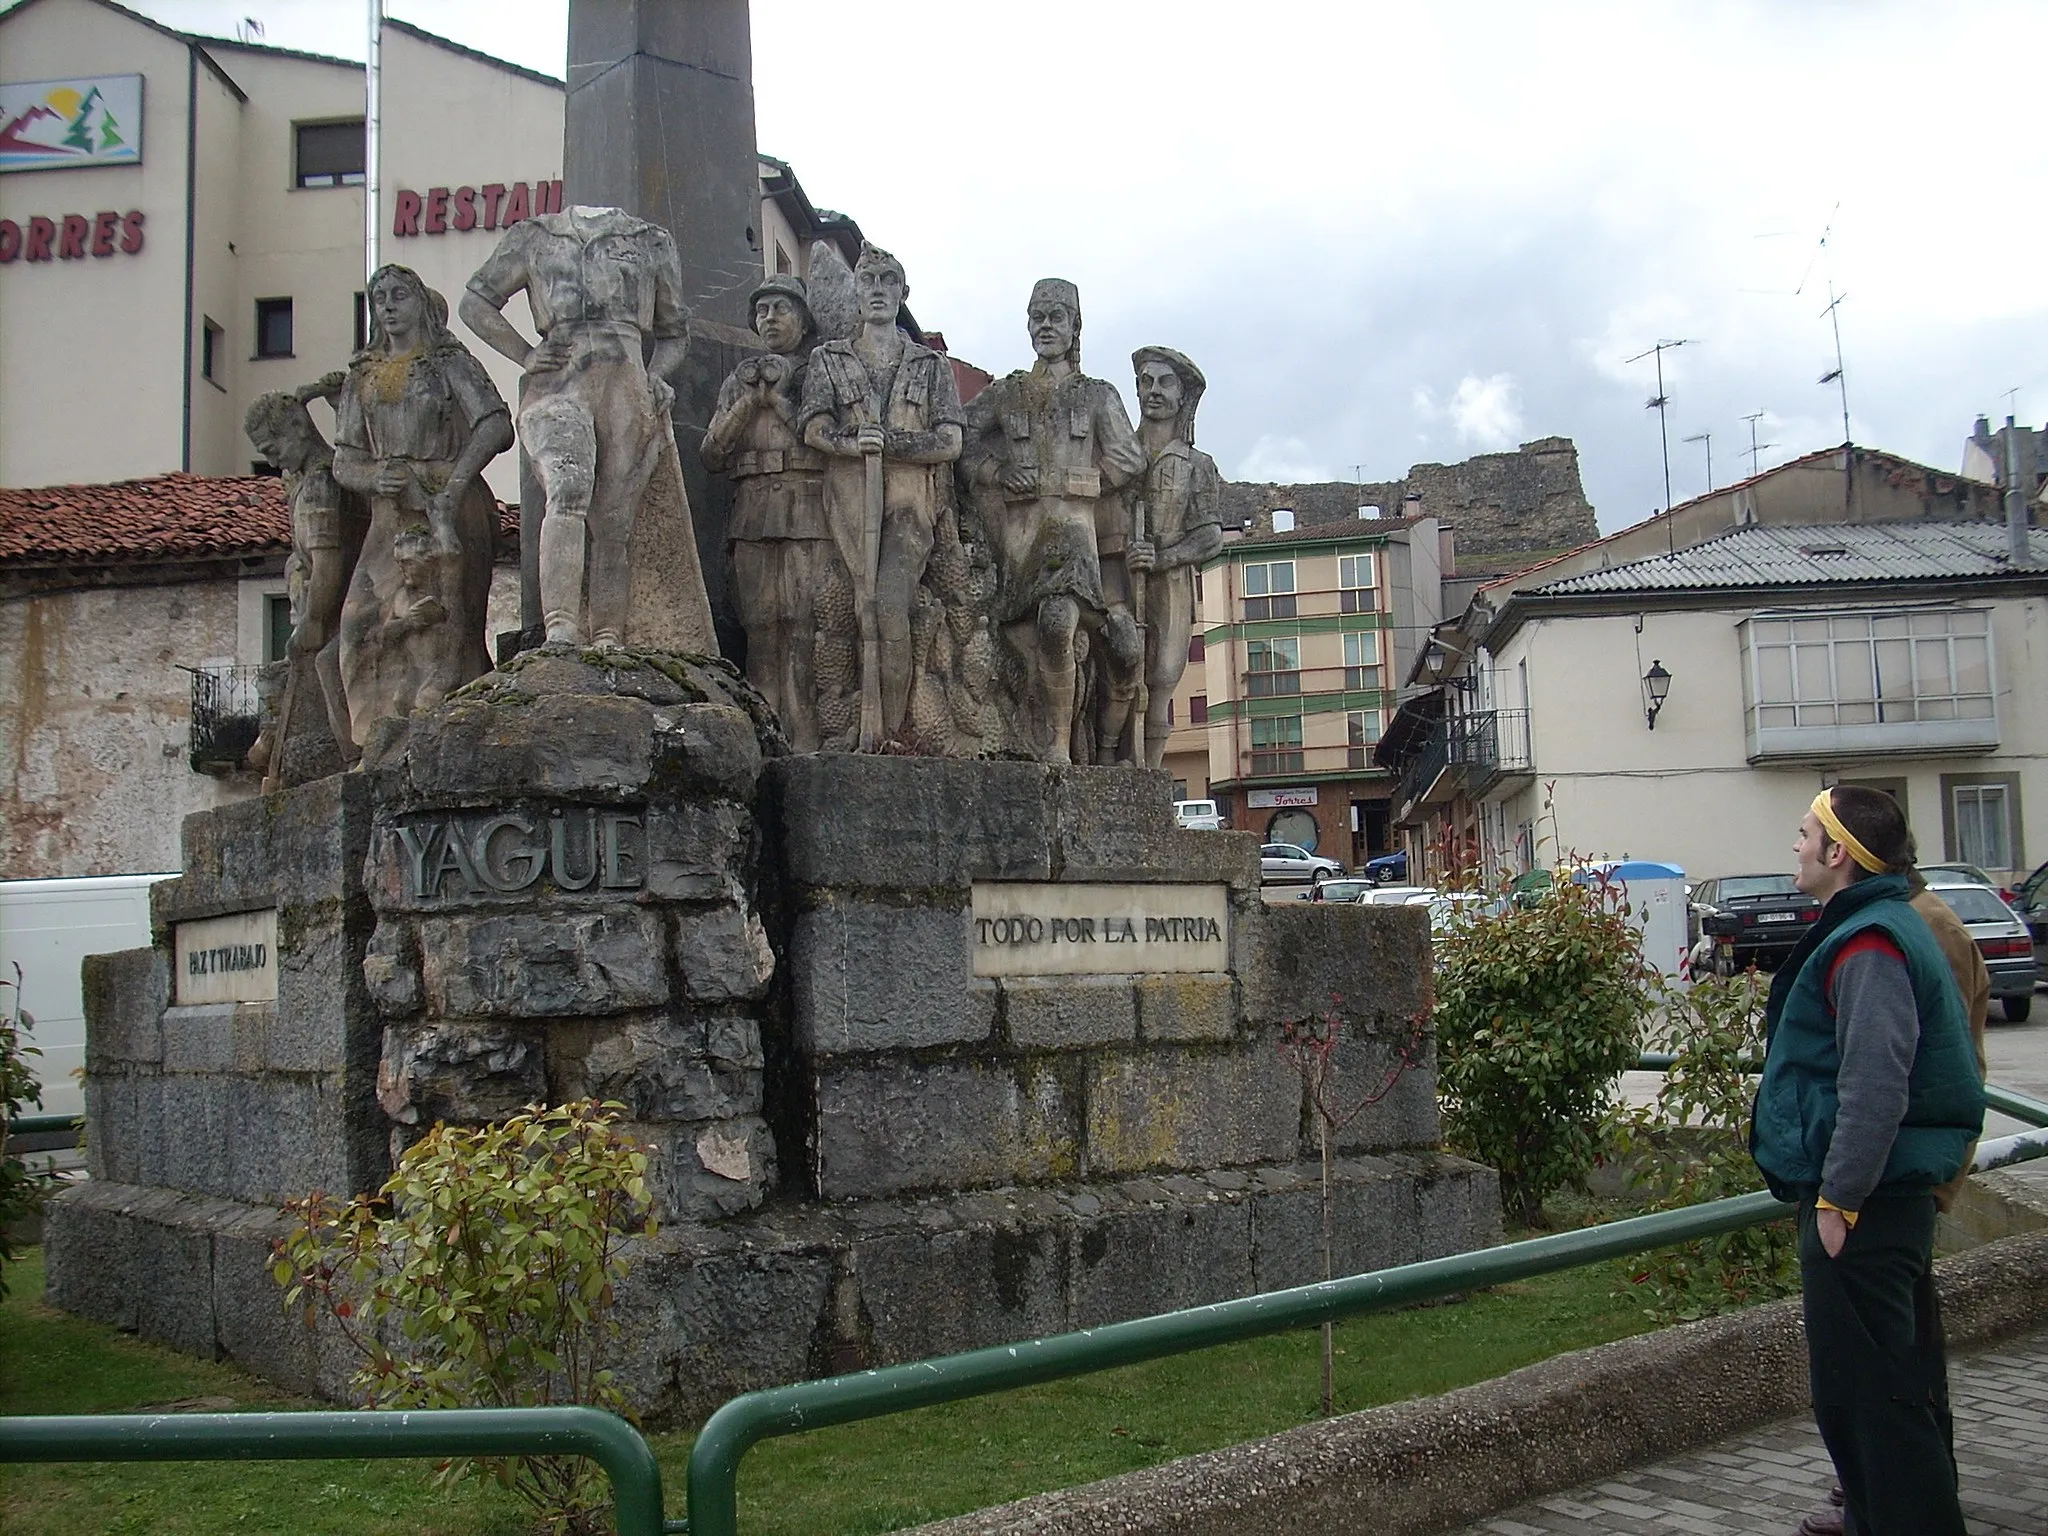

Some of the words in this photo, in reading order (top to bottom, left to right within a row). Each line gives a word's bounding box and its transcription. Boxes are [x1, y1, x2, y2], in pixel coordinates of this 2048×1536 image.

[393, 179, 563, 237] RESTAU
[1275, 795, 1314, 806] Torres
[396, 807, 642, 897] YAGÜE
[975, 917, 1043, 943] TODO
[1051, 917, 1096, 943] POR
[1104, 917, 1138, 943] LA
[1145, 916, 1222, 942] PATRIA
[189, 950, 207, 975] PAZ
[209, 948, 217, 973] Y
[217, 943, 267, 973] TRABAJO
